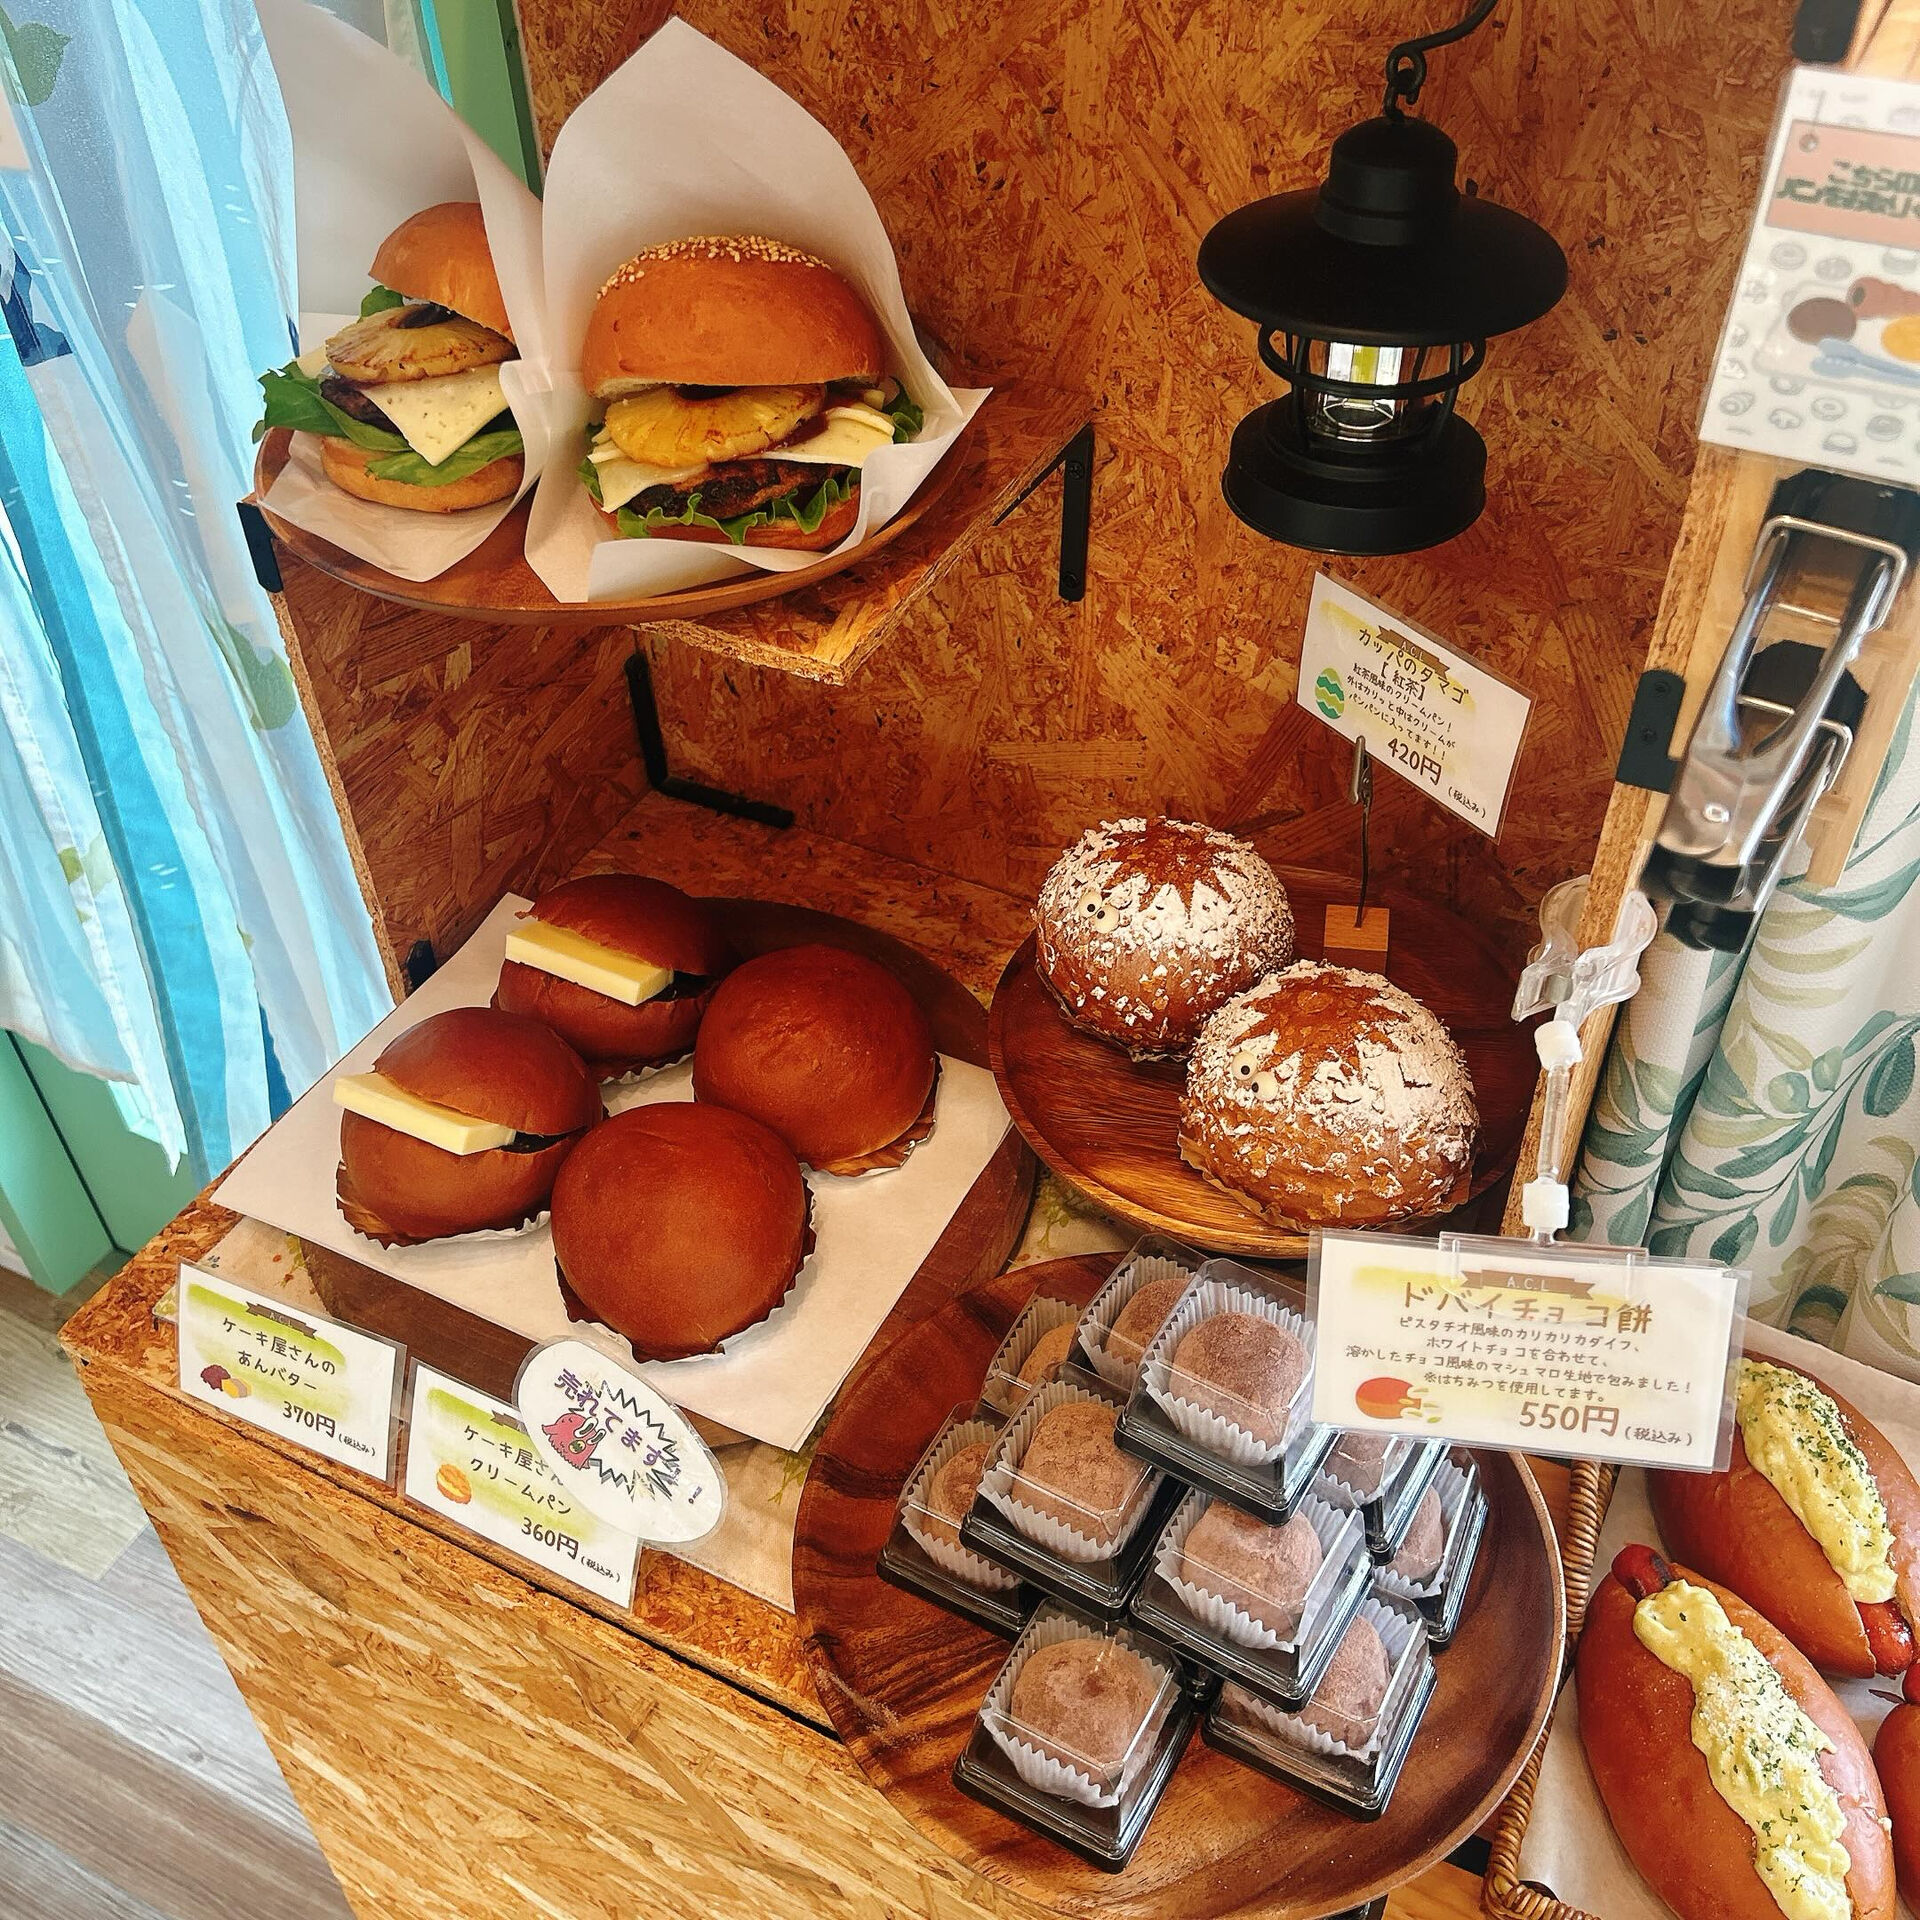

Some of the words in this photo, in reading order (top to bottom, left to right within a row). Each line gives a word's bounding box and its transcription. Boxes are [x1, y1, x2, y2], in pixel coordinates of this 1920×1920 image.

[1358, 628, 1470, 704] カッパのタマゴ
[1381, 662, 1425, 701] 【紅茶】
[1388, 738, 1442, 785] 420円
[1404, 1281, 1653, 1334] ドバイチョコ餅
[222, 1317, 336, 1376] ケーキ屋さんの
[1399, 1316, 1641, 1353] ピスタチオ風味のカリカリカダイフ、
[1426, 1337, 1608, 1368] ホワイトチョコを合わせて、
[237, 1350, 317, 1390] あんバター
[1424, 1371, 1604, 1403] ※はちみつを使用してます。
[282, 1401, 336, 1438] 370円
[1519, 1402, 1620, 1437] 550円
[470, 1458, 571, 1515] クリームパン
[521, 1516, 579, 1560] 360円
